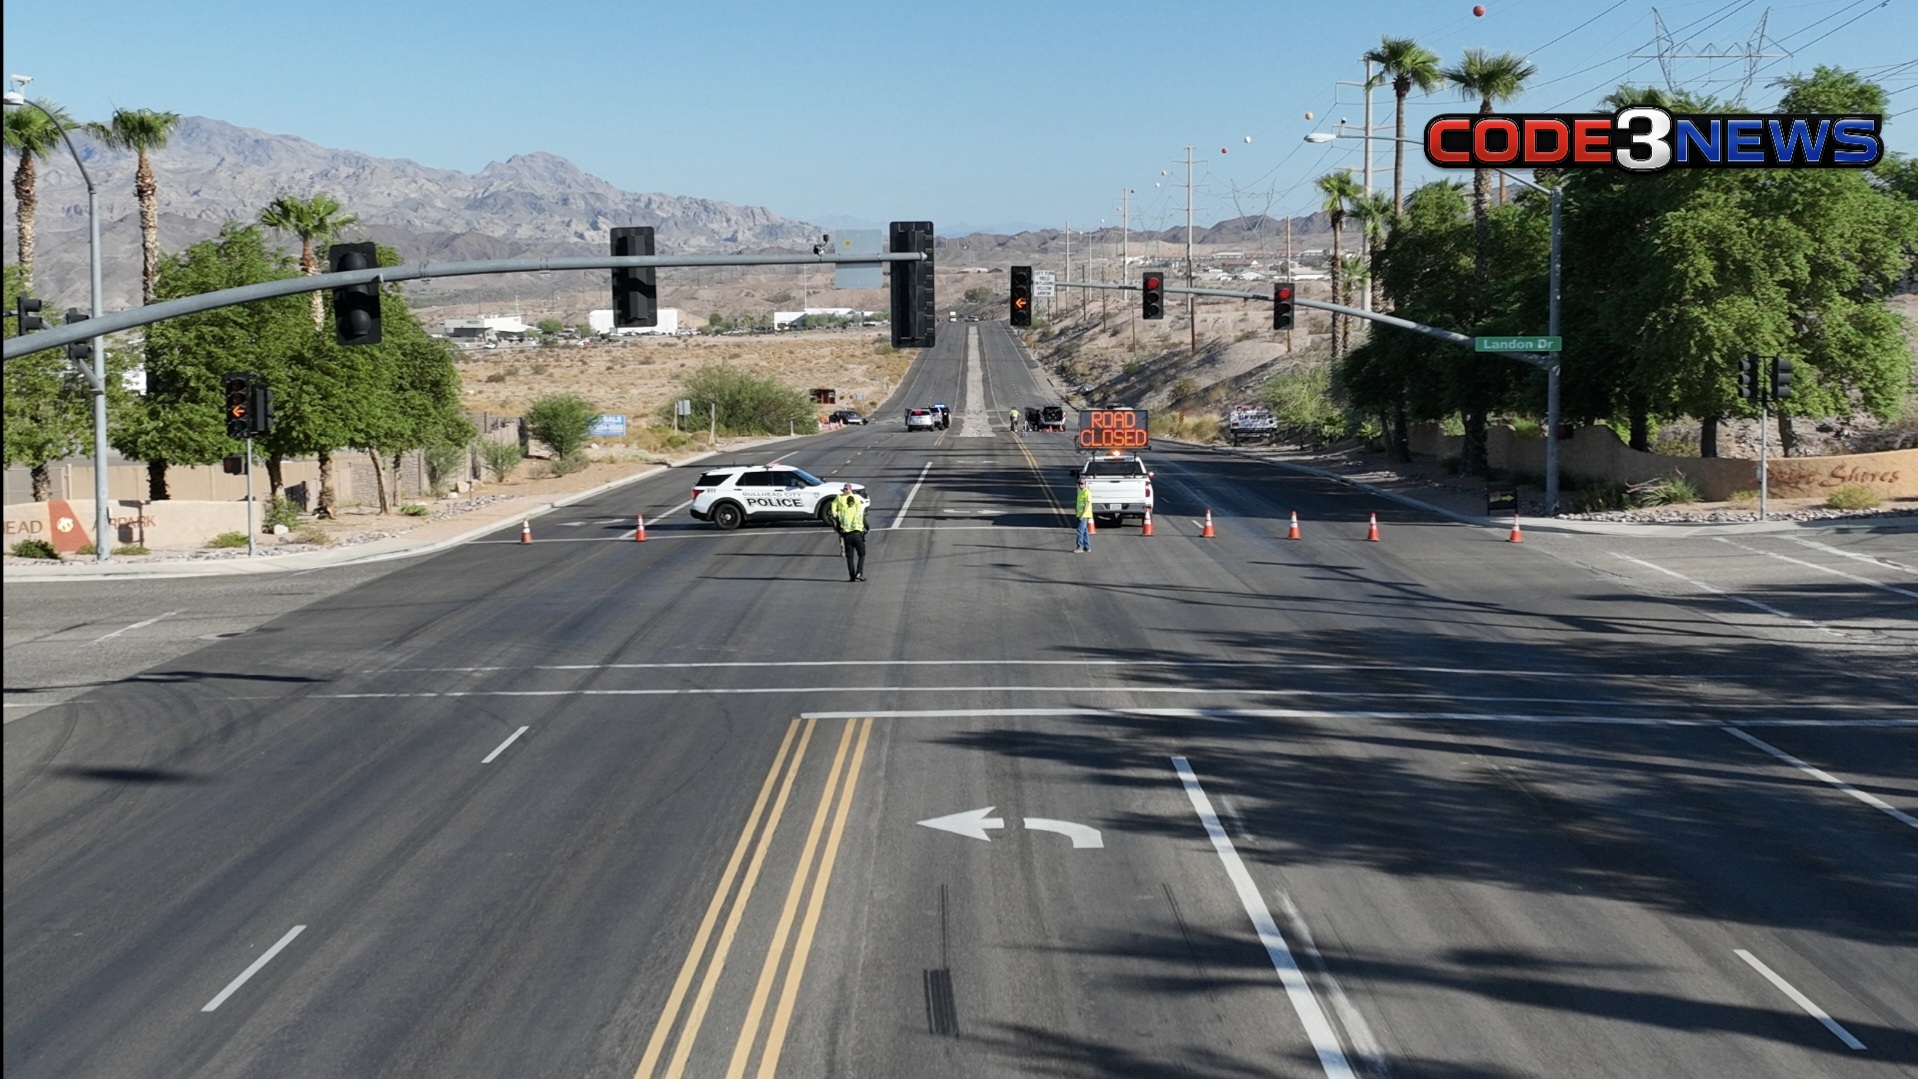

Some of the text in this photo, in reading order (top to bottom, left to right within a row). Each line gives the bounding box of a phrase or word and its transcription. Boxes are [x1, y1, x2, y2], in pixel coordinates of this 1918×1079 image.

[1483, 339, 1554, 349] Landon Dr
[1091, 411, 1136, 428] ROAD
[1080, 429, 1147, 447] CLOSED
[746, 498, 804, 508] POLICE
